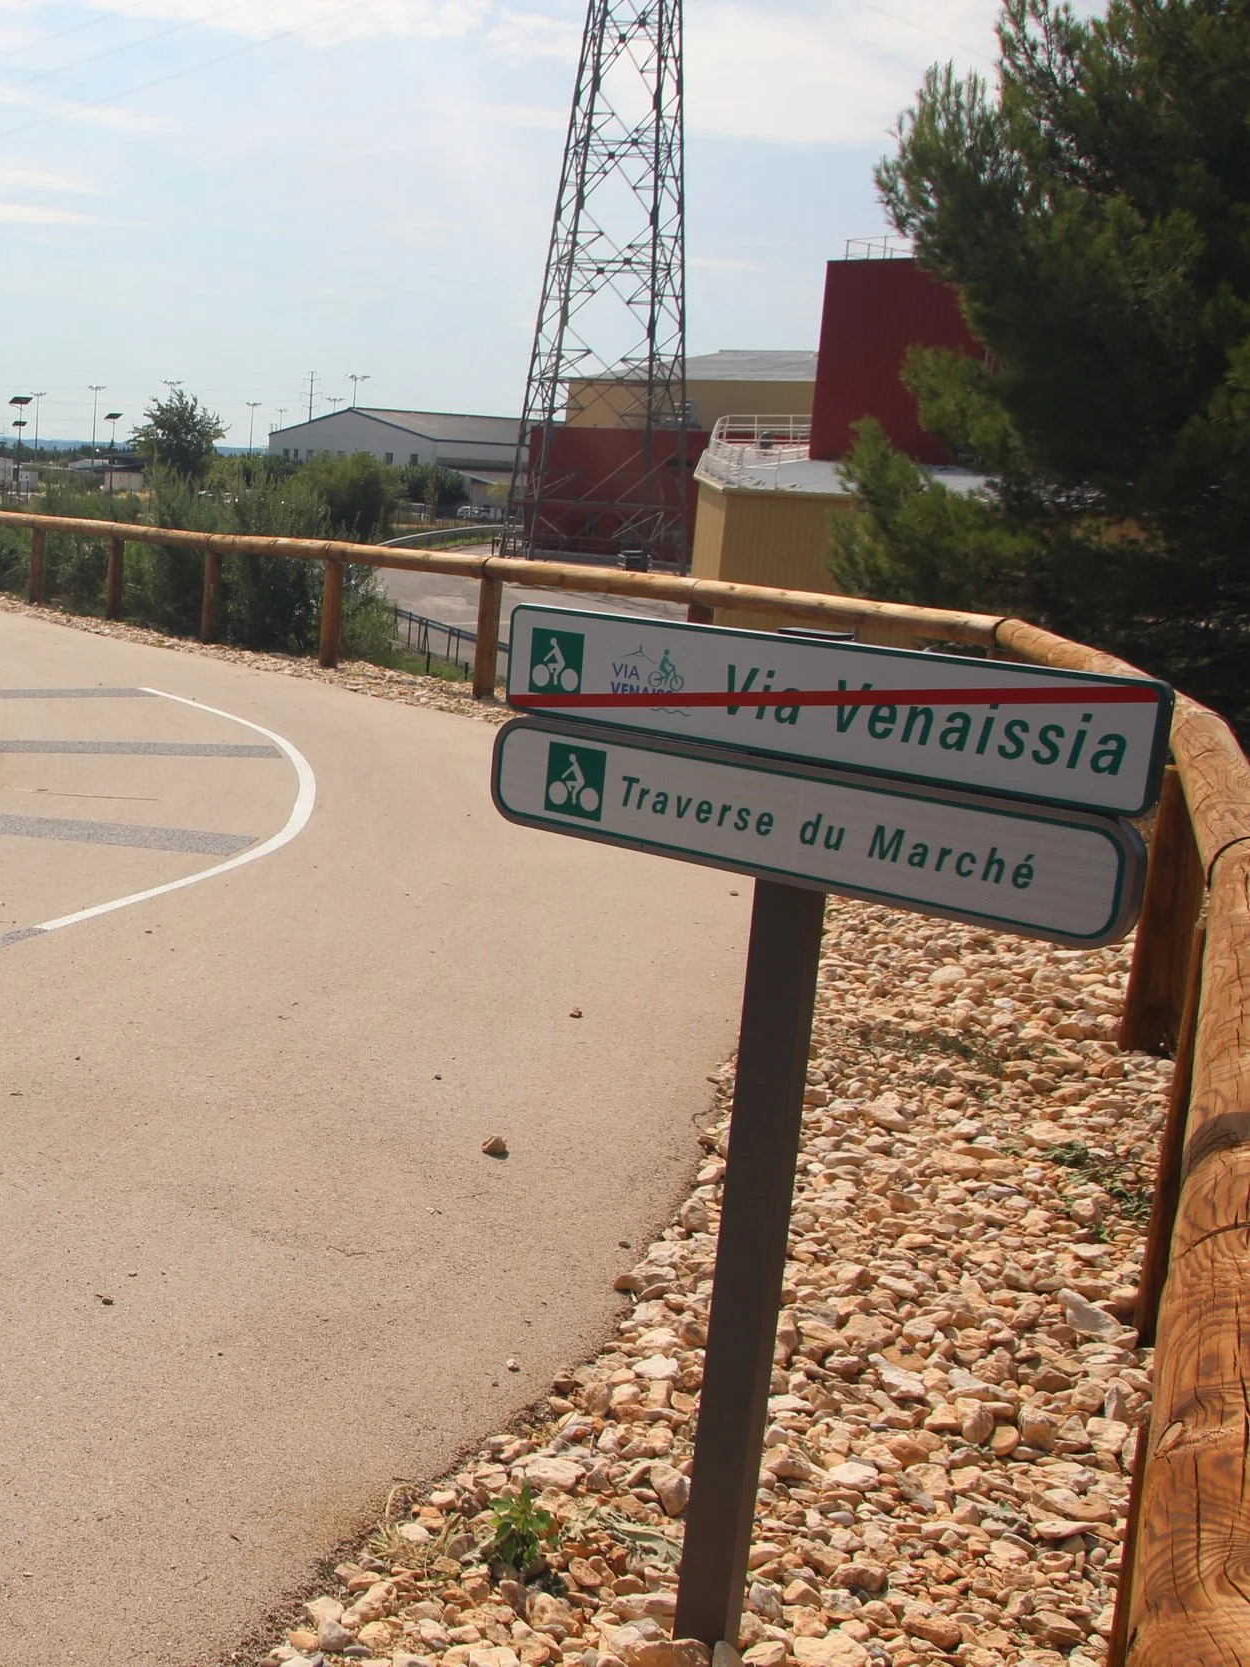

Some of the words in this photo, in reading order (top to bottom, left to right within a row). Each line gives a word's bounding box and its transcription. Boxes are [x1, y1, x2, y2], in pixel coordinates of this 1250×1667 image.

[612, 661, 640, 681] VIA
[726, 663, 800, 726] Via
[836, 679, 1127, 776] Venaissia
[621, 775, 775, 836] Traverse
[799, 813, 846, 851] du
[867, 824, 1035, 889] Marché
